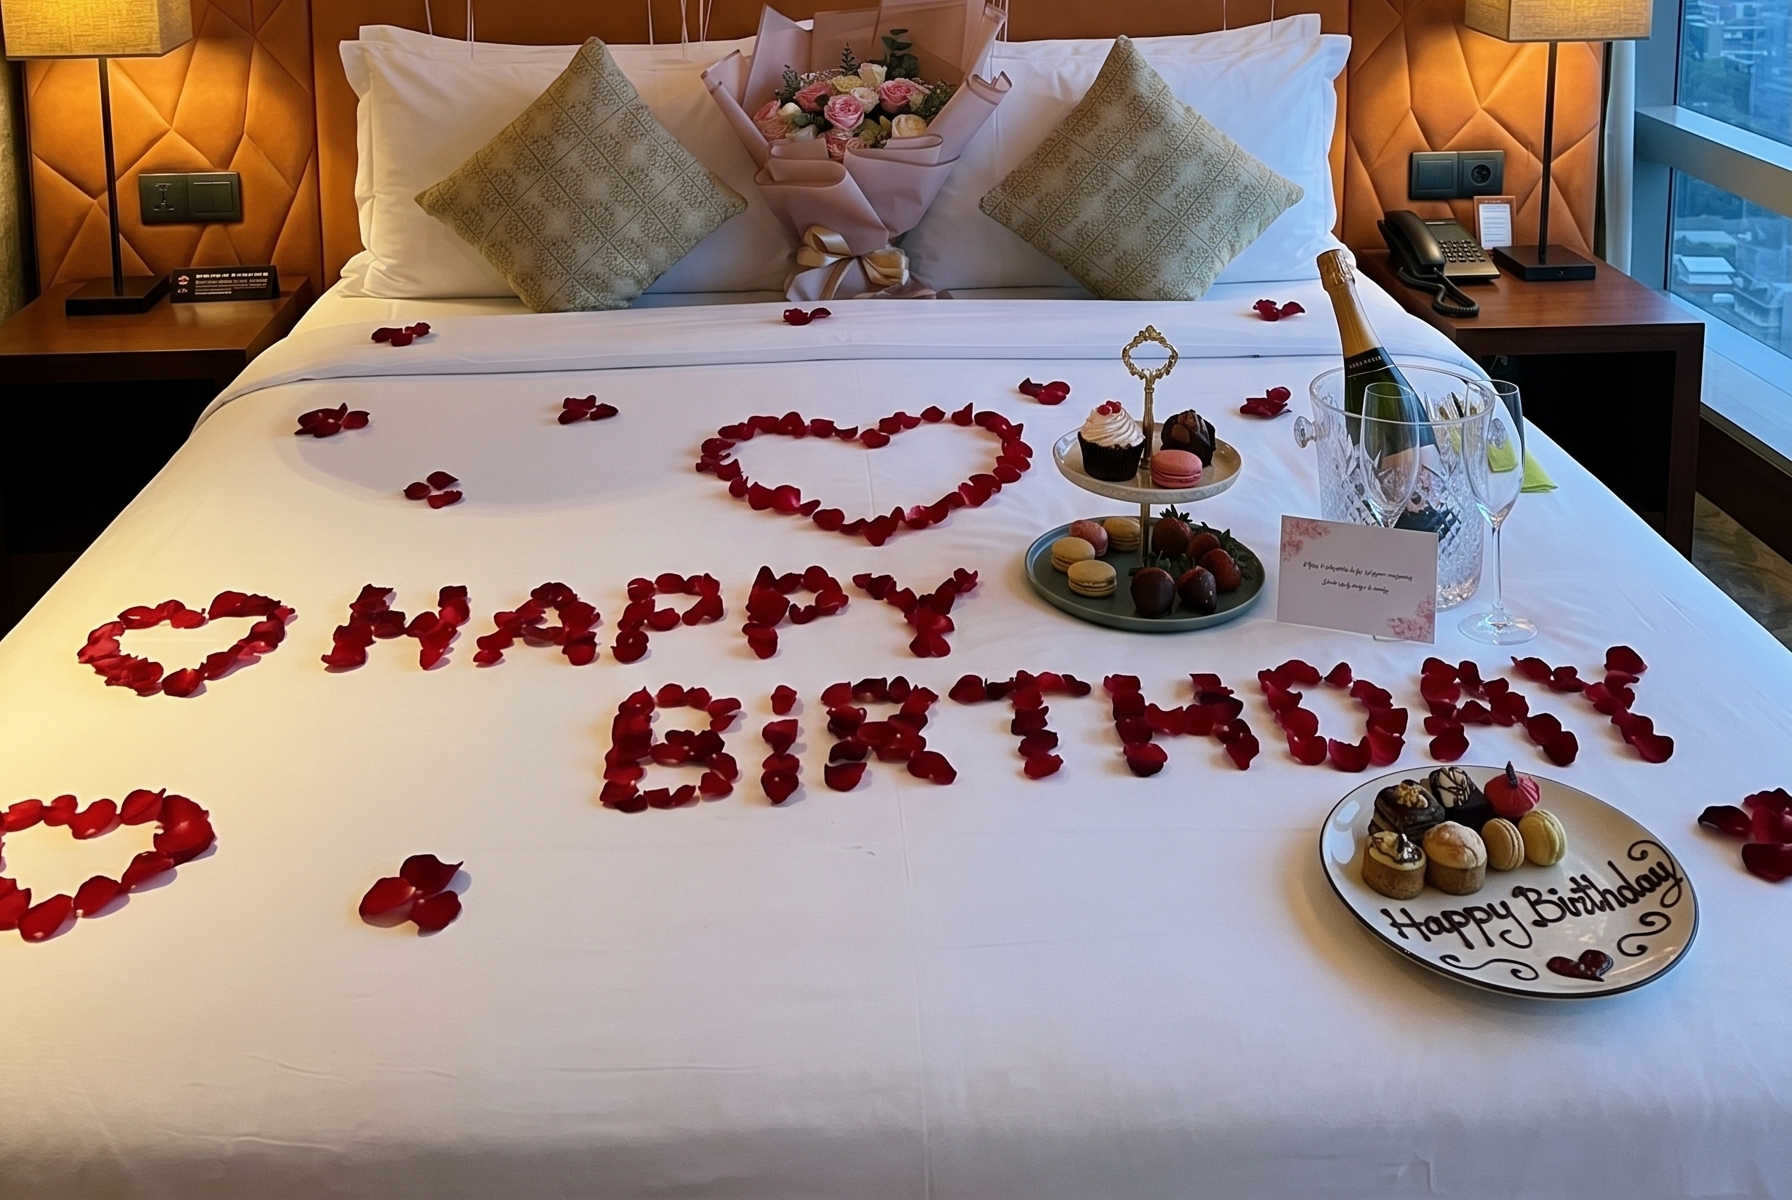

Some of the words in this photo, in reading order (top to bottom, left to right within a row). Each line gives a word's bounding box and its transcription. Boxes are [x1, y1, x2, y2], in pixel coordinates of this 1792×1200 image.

[322, 565, 979, 669] HAPPY
[1380, 900, 1533, 949] Happy
[1511, 841, 1684, 927] Birthday
